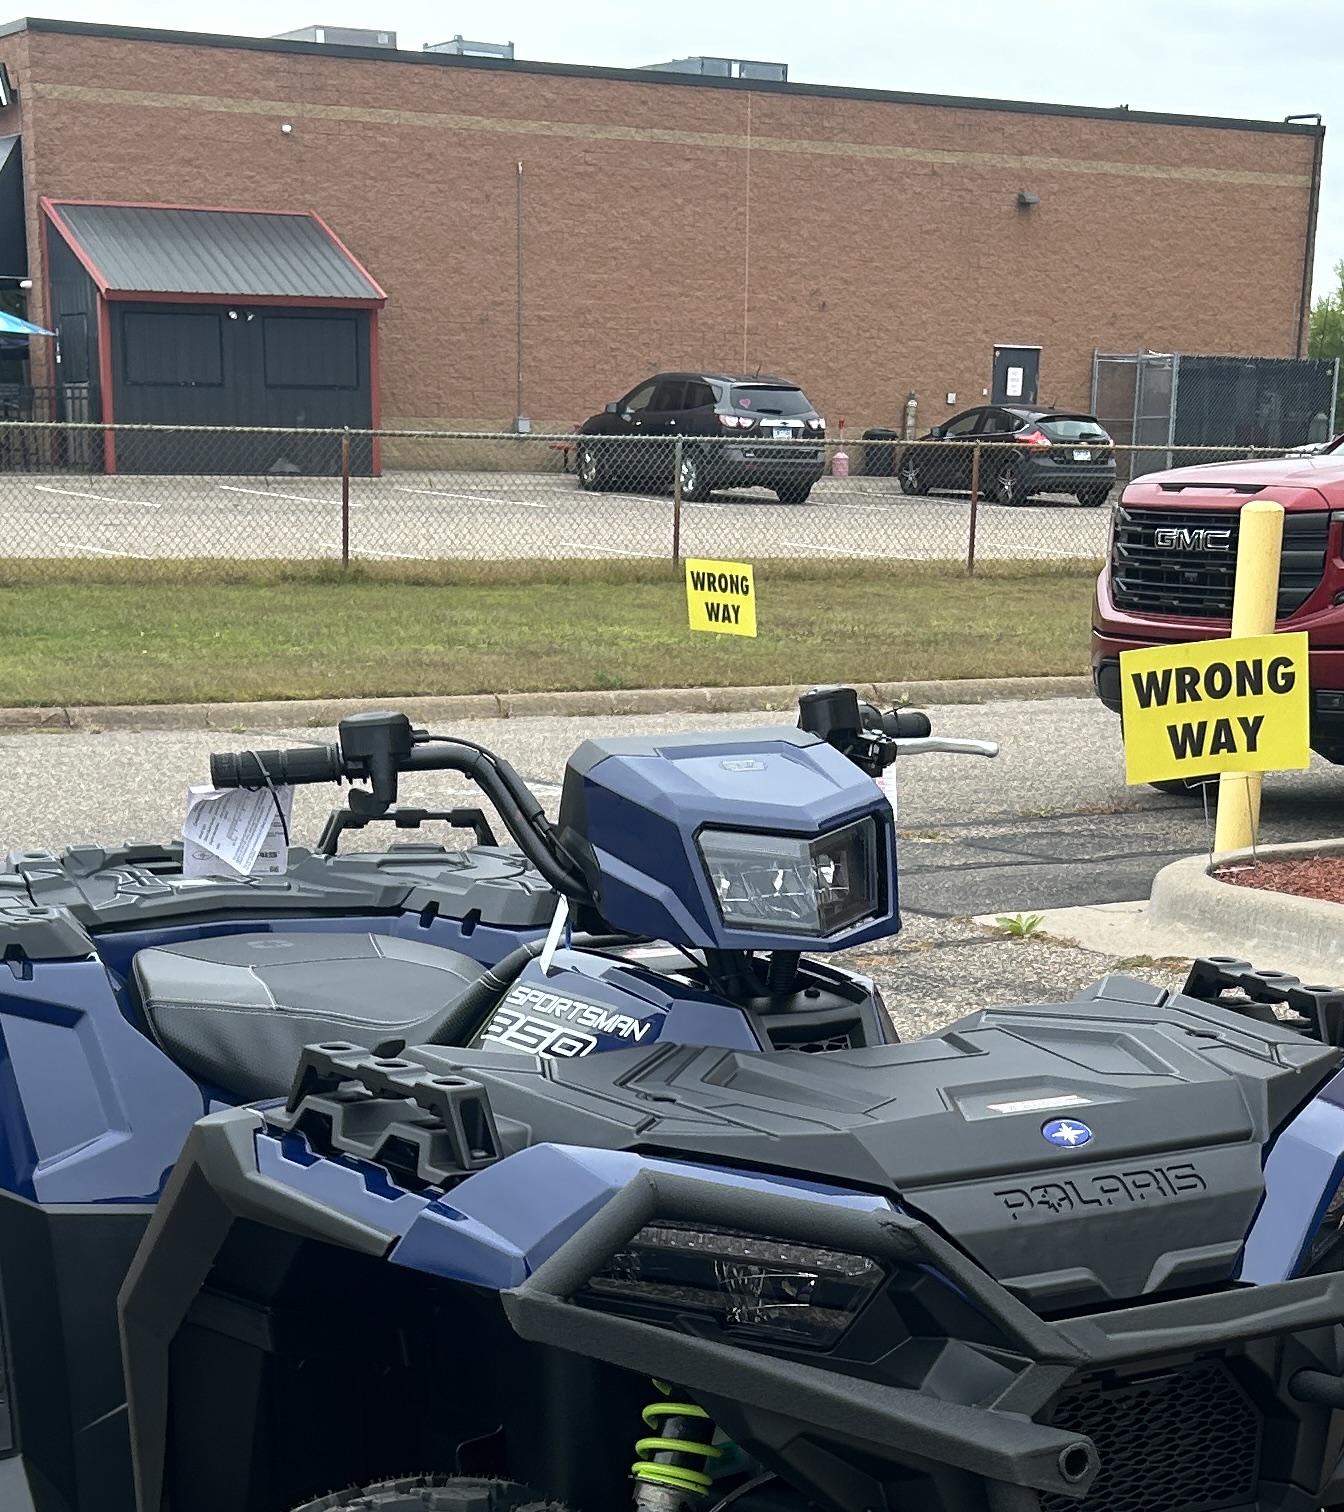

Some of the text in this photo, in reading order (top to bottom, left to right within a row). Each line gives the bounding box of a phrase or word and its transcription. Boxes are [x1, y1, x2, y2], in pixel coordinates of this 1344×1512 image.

[1155, 528, 1231, 551] GMC
[690, 570, 750, 596] WRONG
[704, 601, 741, 624] WAY
[1131, 656, 1296, 709] WRONG
[1167, 715, 1265, 761] WAY
[507, 985, 651, 1041] SPORTSMAN
[993, 1163, 1208, 1220] POLARIS
